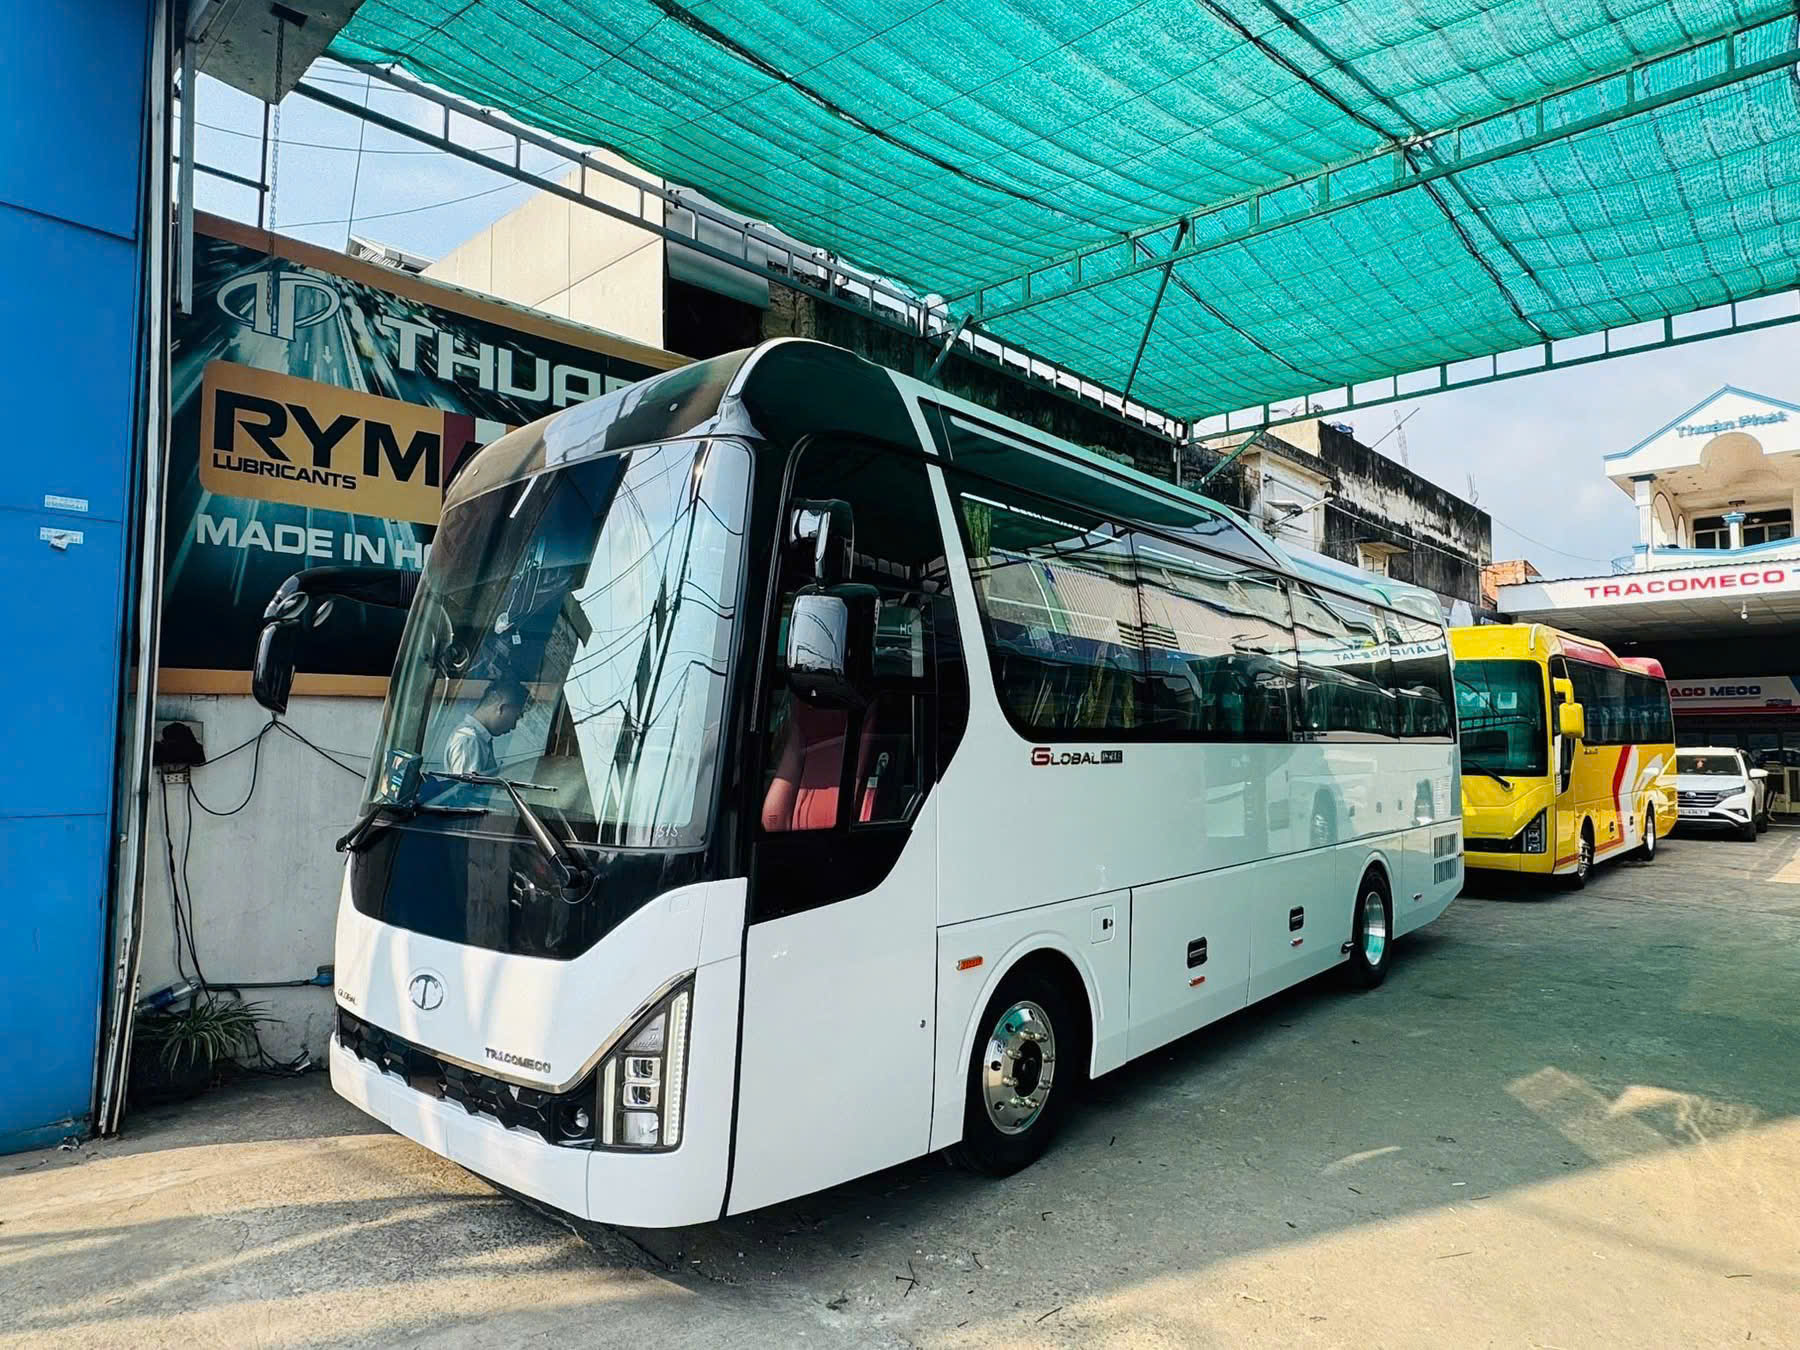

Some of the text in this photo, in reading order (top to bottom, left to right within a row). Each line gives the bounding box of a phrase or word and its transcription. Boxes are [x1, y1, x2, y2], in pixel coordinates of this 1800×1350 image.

[213, 453, 356, 489] LUBRICANTS
[197, 513, 333, 558] MADE
[344, 532, 385, 564] IN
[1584, 570, 1785, 599] TRACOMECO
[1031, 747, 1100, 766] GLOBAL
[485, 1047, 552, 1074] TRACOMECO
